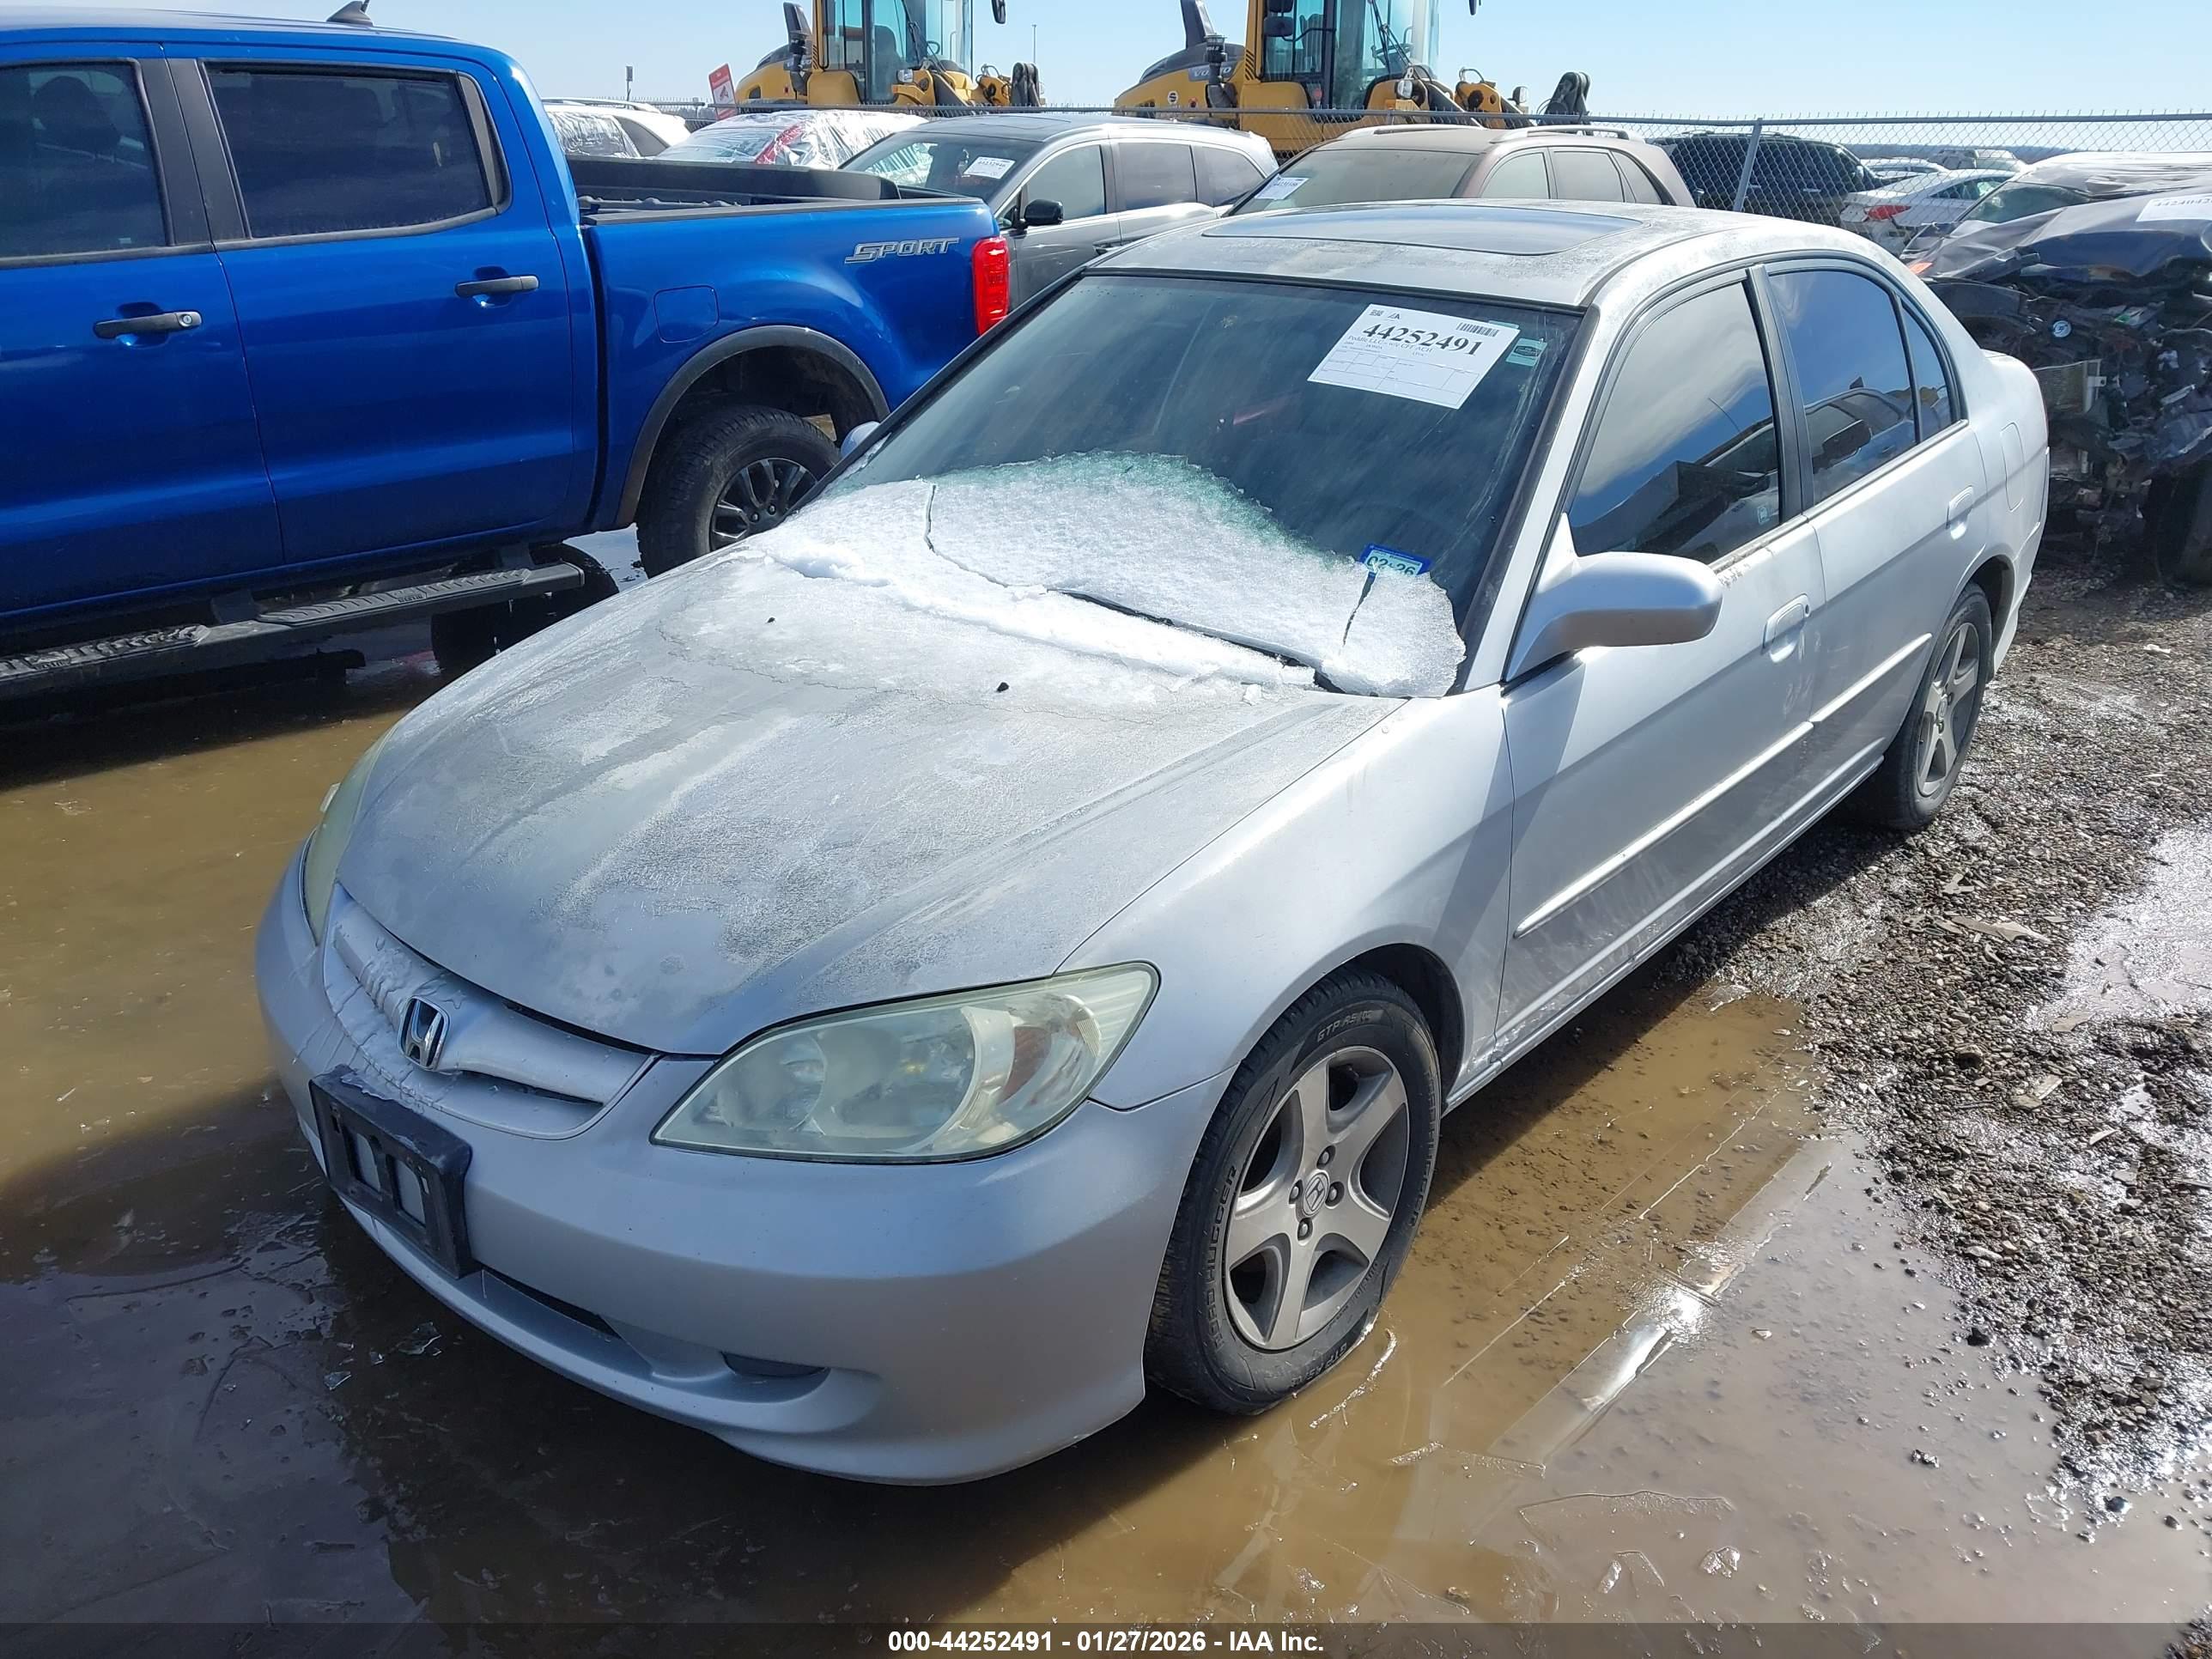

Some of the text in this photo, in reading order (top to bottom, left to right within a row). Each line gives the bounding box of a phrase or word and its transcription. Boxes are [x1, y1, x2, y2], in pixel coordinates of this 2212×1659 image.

[845, 237, 960, 264] SPORT
[1362, 324, 1483, 356] 44252491
[1317, 1020, 1341, 1042] GTP
[1206, 1164, 1237, 1284] HUGGER
